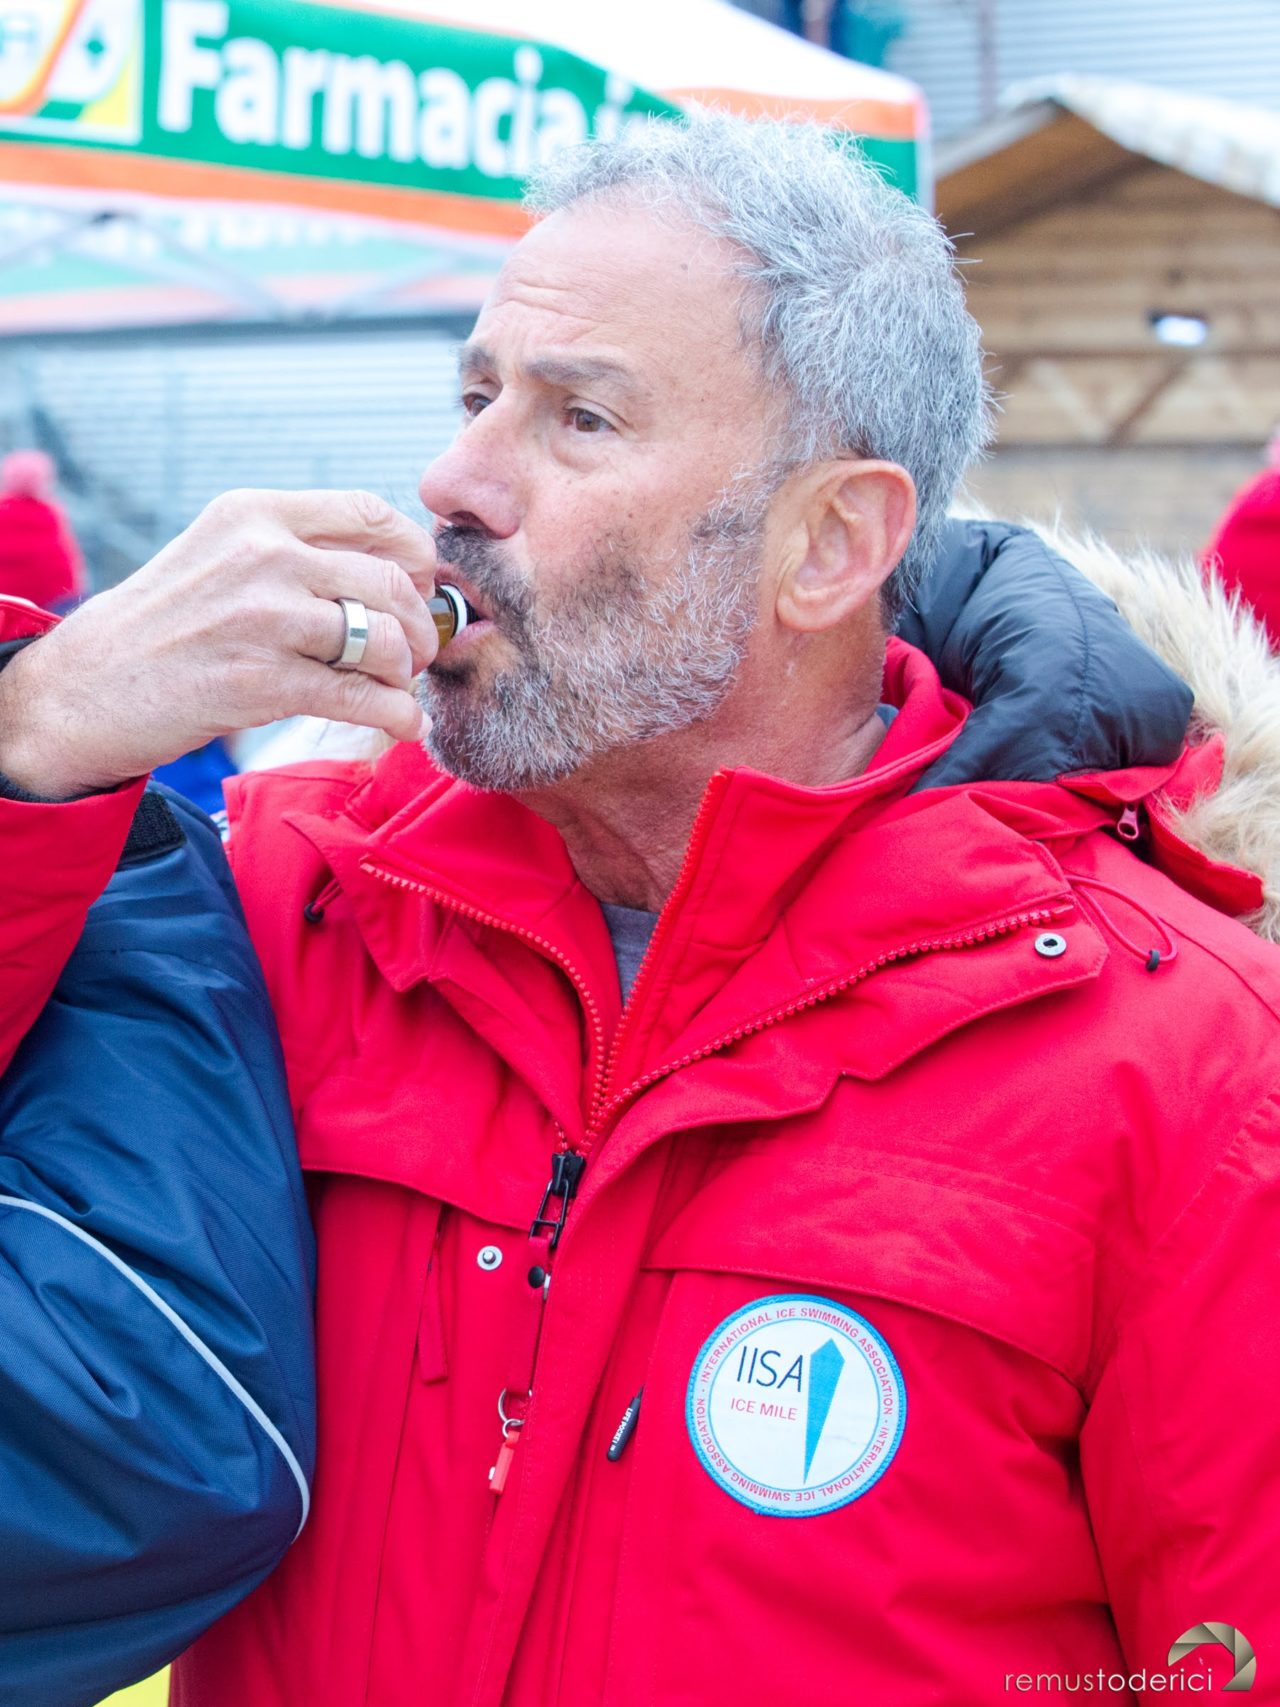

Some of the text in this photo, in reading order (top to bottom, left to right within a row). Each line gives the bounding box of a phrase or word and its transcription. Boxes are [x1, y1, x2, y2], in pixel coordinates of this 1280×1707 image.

[156, 0, 592, 182] Farmacia
[695, 1307, 894, 1502] INTERNATIONAL ICE SWIMMING ASSOCIATION INTERNATIONAL ICE SWIMMING ASSOCIATION
[730, 1397, 799, 1421] ICE MILE
[735, 1345, 804, 1393] IISA
